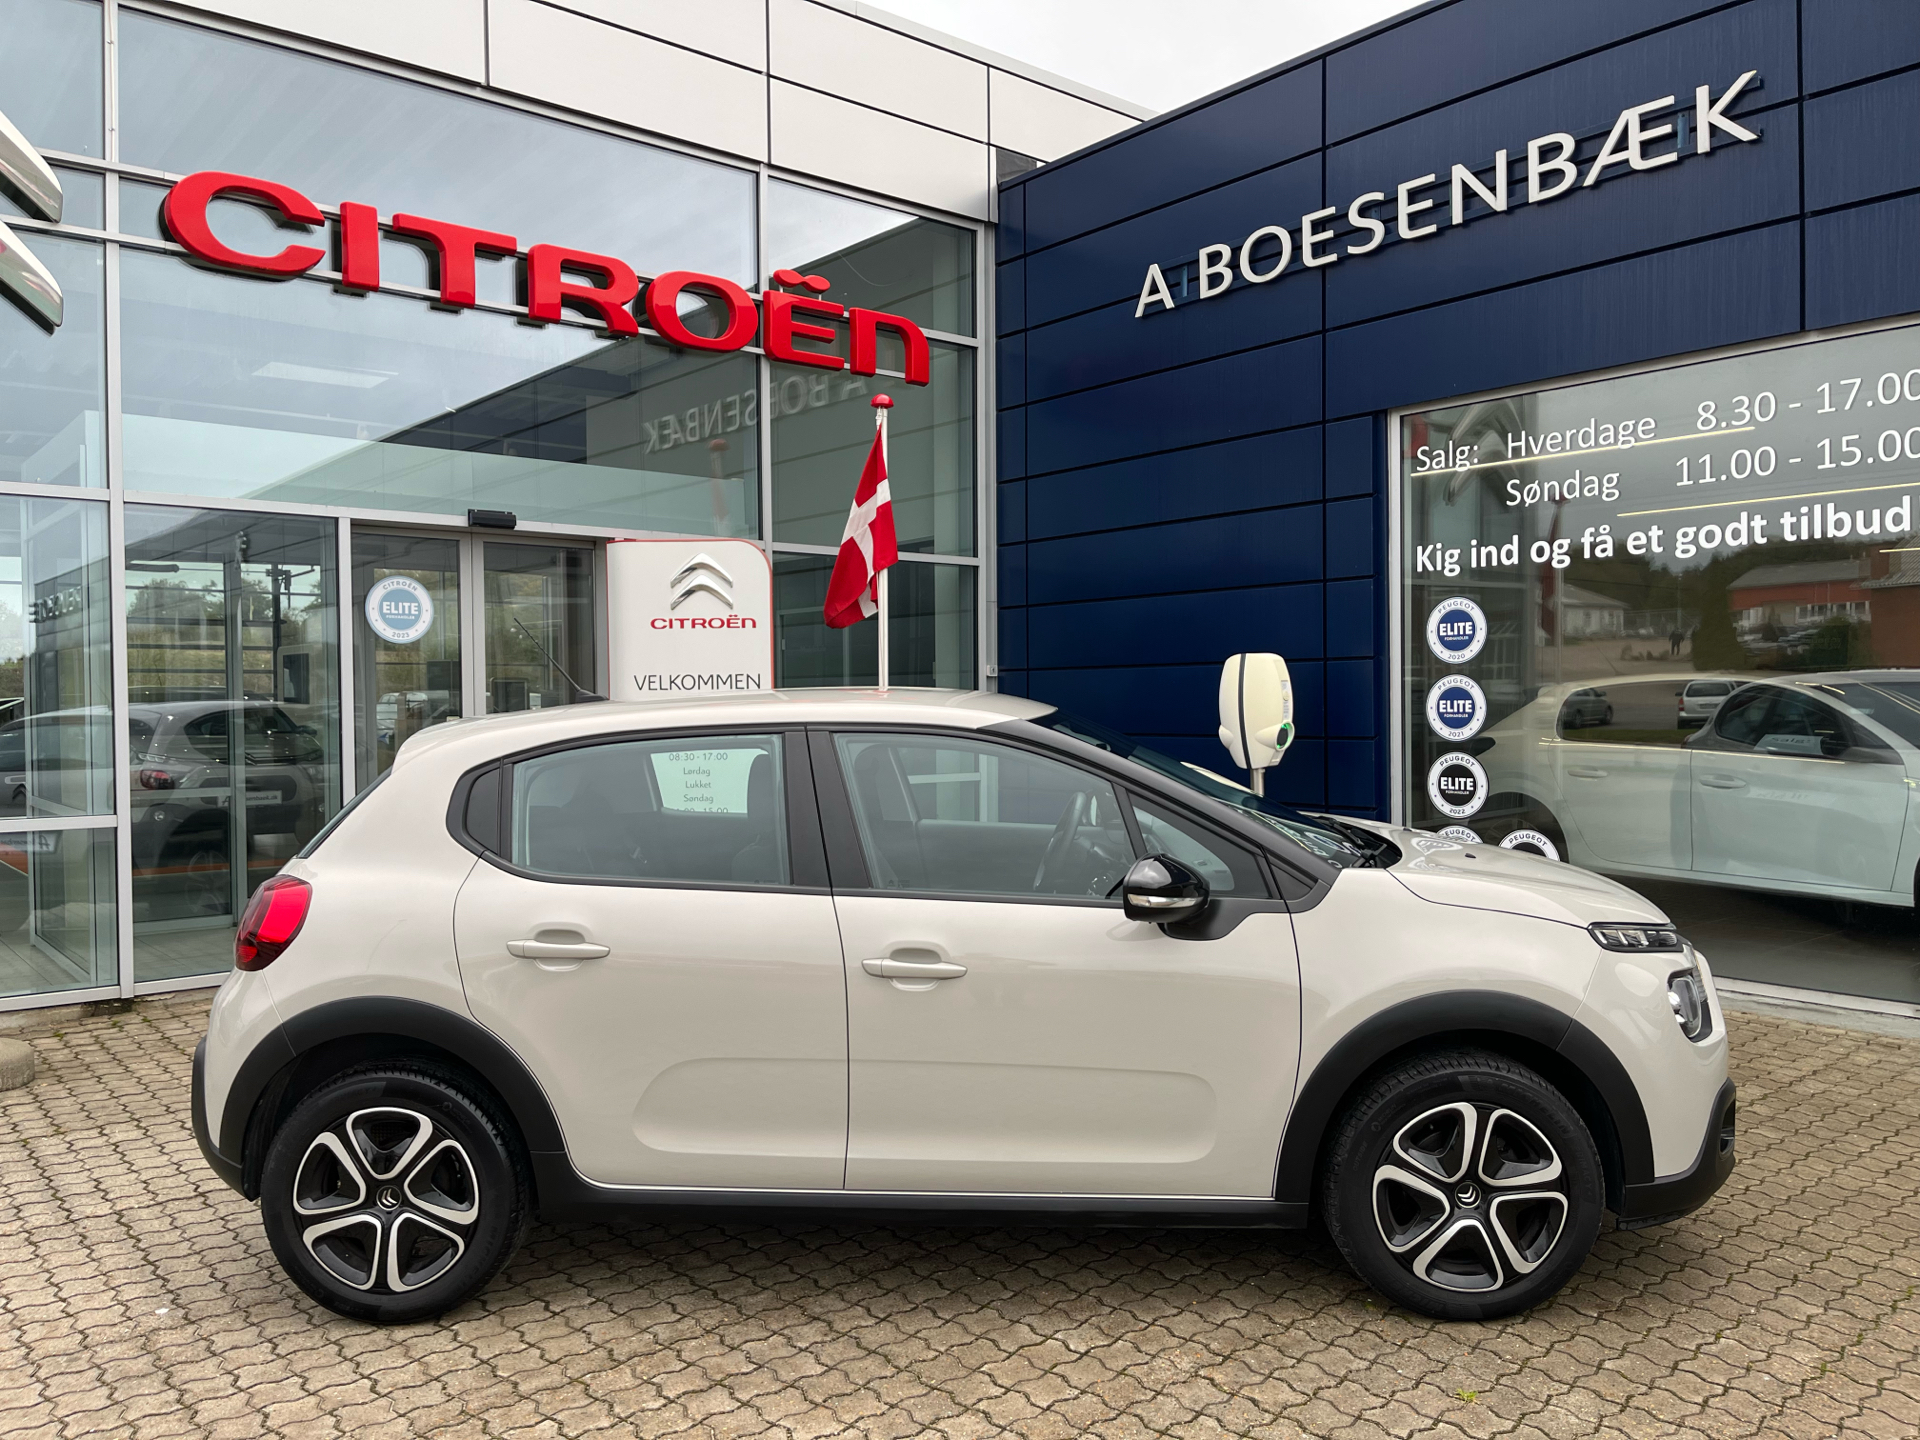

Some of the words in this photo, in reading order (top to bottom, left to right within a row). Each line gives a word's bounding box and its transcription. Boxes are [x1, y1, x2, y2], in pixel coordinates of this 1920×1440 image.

[1134, 262, 1176, 319] A
[1198, 69, 1760, 300] BOESENBÆK
[163, 171, 930, 387] CITROËN
[1416, 440, 1480, 473] Salg:
[1507, 417, 1657, 459] Hverdage
[1696, 391, 1777, 431] 8.30
[1788, 401, 1803, 410] -
[1816, 368, 1920, 415] 17.00
[1506, 469, 1621, 508] Søndag
[1675, 445, 1777, 488] 11.00
[1816, 426, 1920, 470] 15.00
[1416, 543, 1462, 577] Kig
[1470, 534, 1520, 569] ind
[1530, 537, 1572, 569] og
[1581, 524, 1614, 559] få
[1626, 525, 1664, 556] et
[1675, 510, 1768, 559] godt
[1780, 494, 1920, 542] tilbud
[382, 601, 419, 614] ELITE
[1437, 600, 1475, 614] PEUGEOT
[650, 614, 757, 630] CITROËN
[1439, 621, 1473, 636] ELITE
[634, 673, 761, 691] VELKOMMEN
[1437, 677, 1475, 691] PEUGEOT
[1439, 699, 1473, 713] ELITE
[668, 752, 695, 762] 08:30
[702, 752, 728, 761] 17:00
[1439, 755, 1476, 768] PEUGEOT
[683, 766, 711, 777] Lørdag
[685, 780, 712, 789] Lukket
[1440, 776, 1474, 791] ELITE
[683, 793, 714, 804] Søndag
[1508, 832, 1548, 847] PEUGEOT
